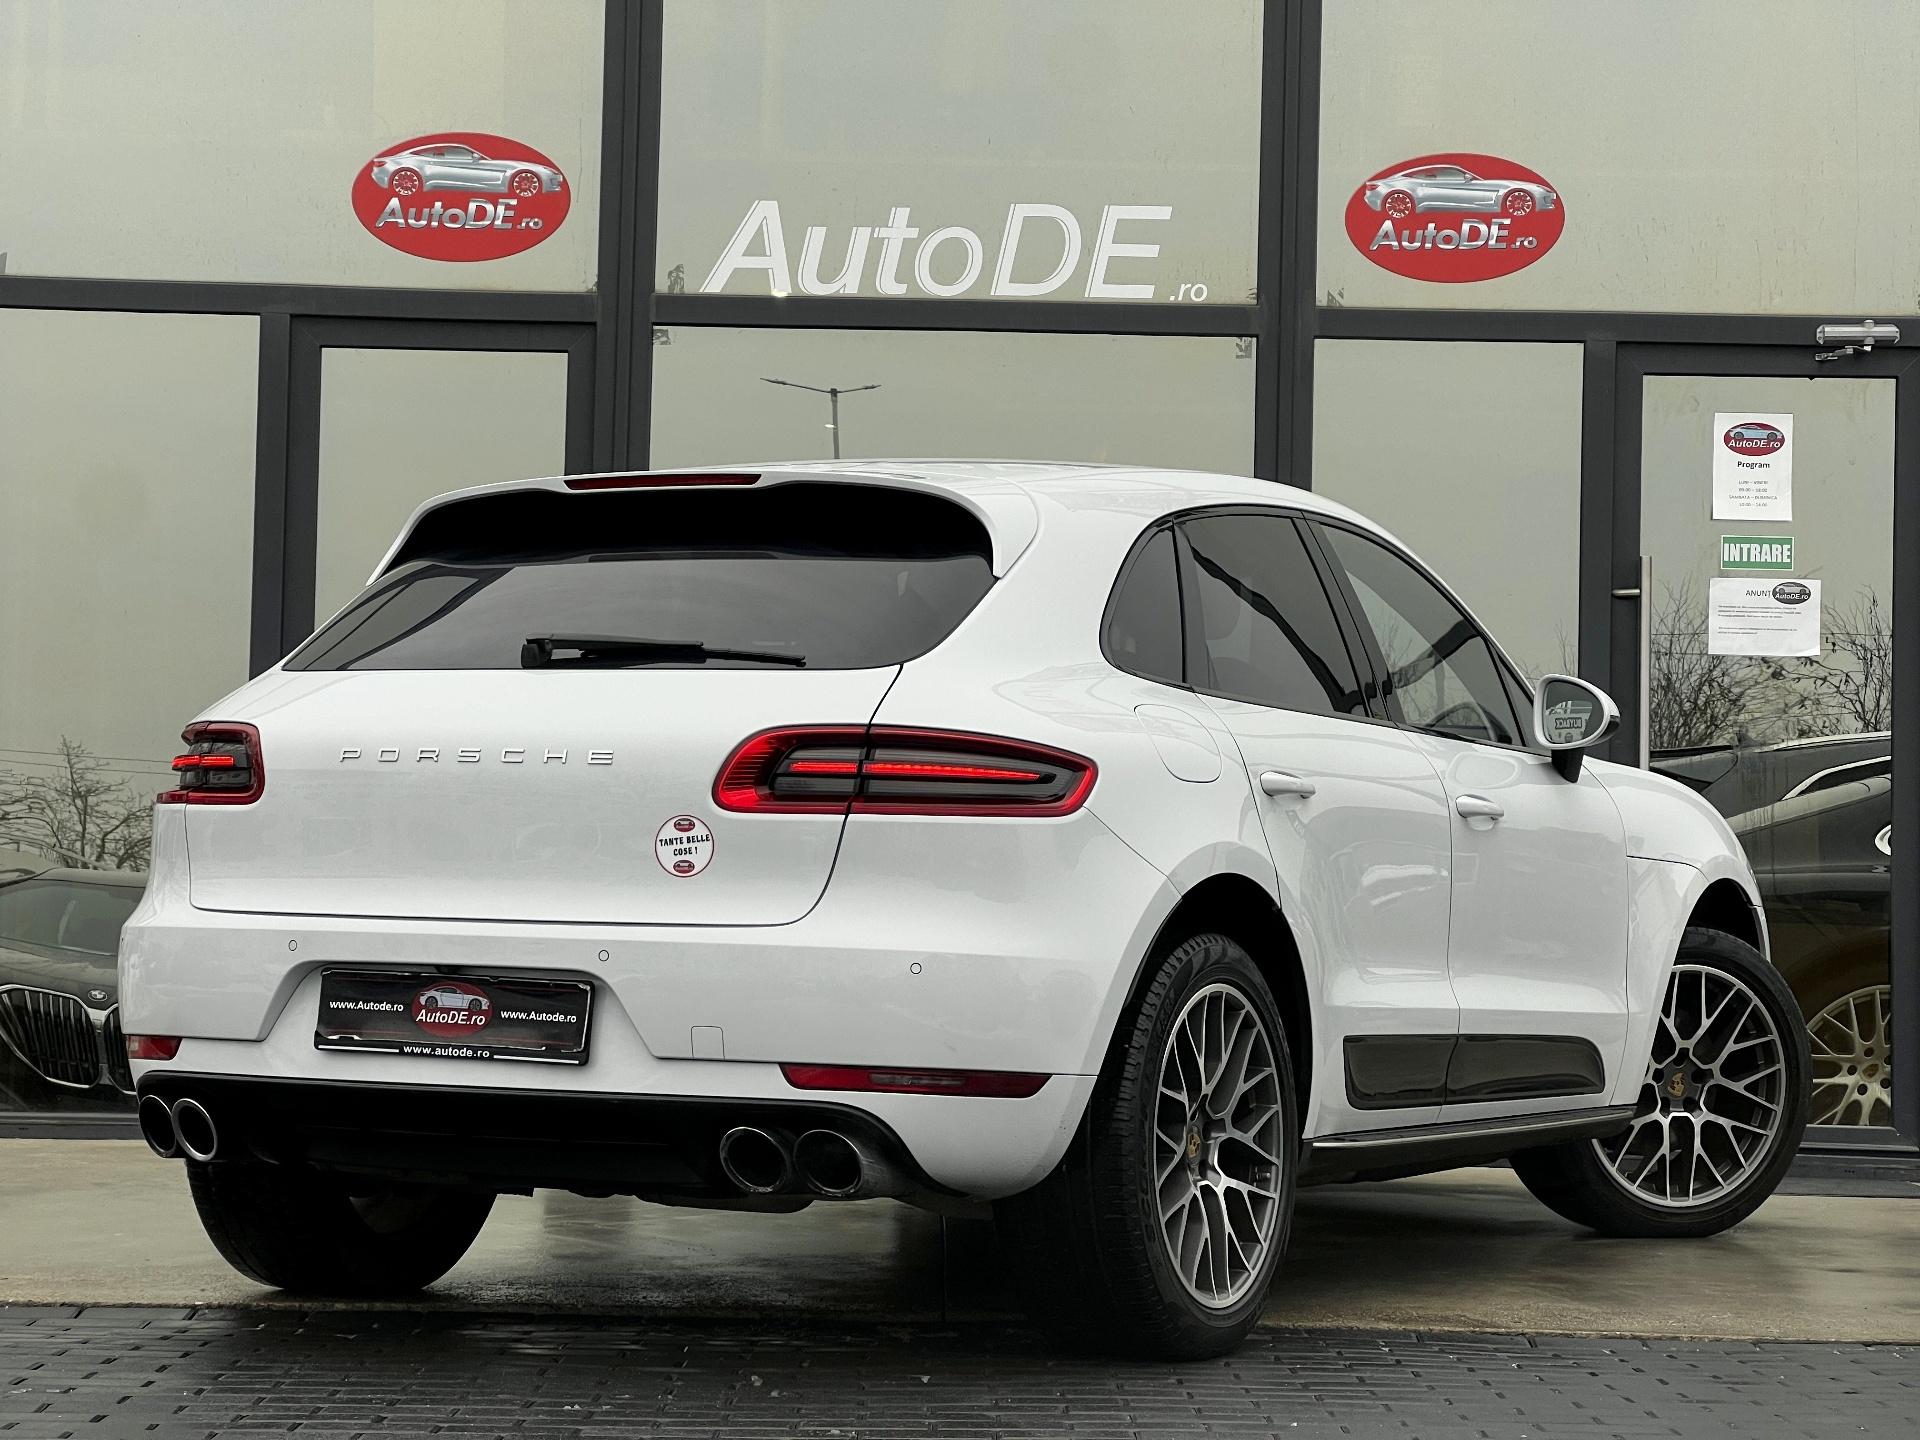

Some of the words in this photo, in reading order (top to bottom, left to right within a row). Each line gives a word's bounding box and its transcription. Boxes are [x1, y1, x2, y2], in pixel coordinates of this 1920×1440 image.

[1728, 439, 1781, 448] AutoDE.ro
[1737, 461, 1771, 469] Program
[1723, 543, 1791, 563] INTRARE
[340, 748, 614, 765] PORSCHE
[659, 837, 684, 847] TANTE
[686, 833, 710, 844] BELLE
[673, 846, 693, 856] COSE
[329, 1000, 404, 1012] www.Autode.ro
[416, 1009, 486, 1026] AutoDE.ro
[500, 1010, 577, 1023] www.Autode.ro
[403, 1044, 490, 1058] www.autode.ro
